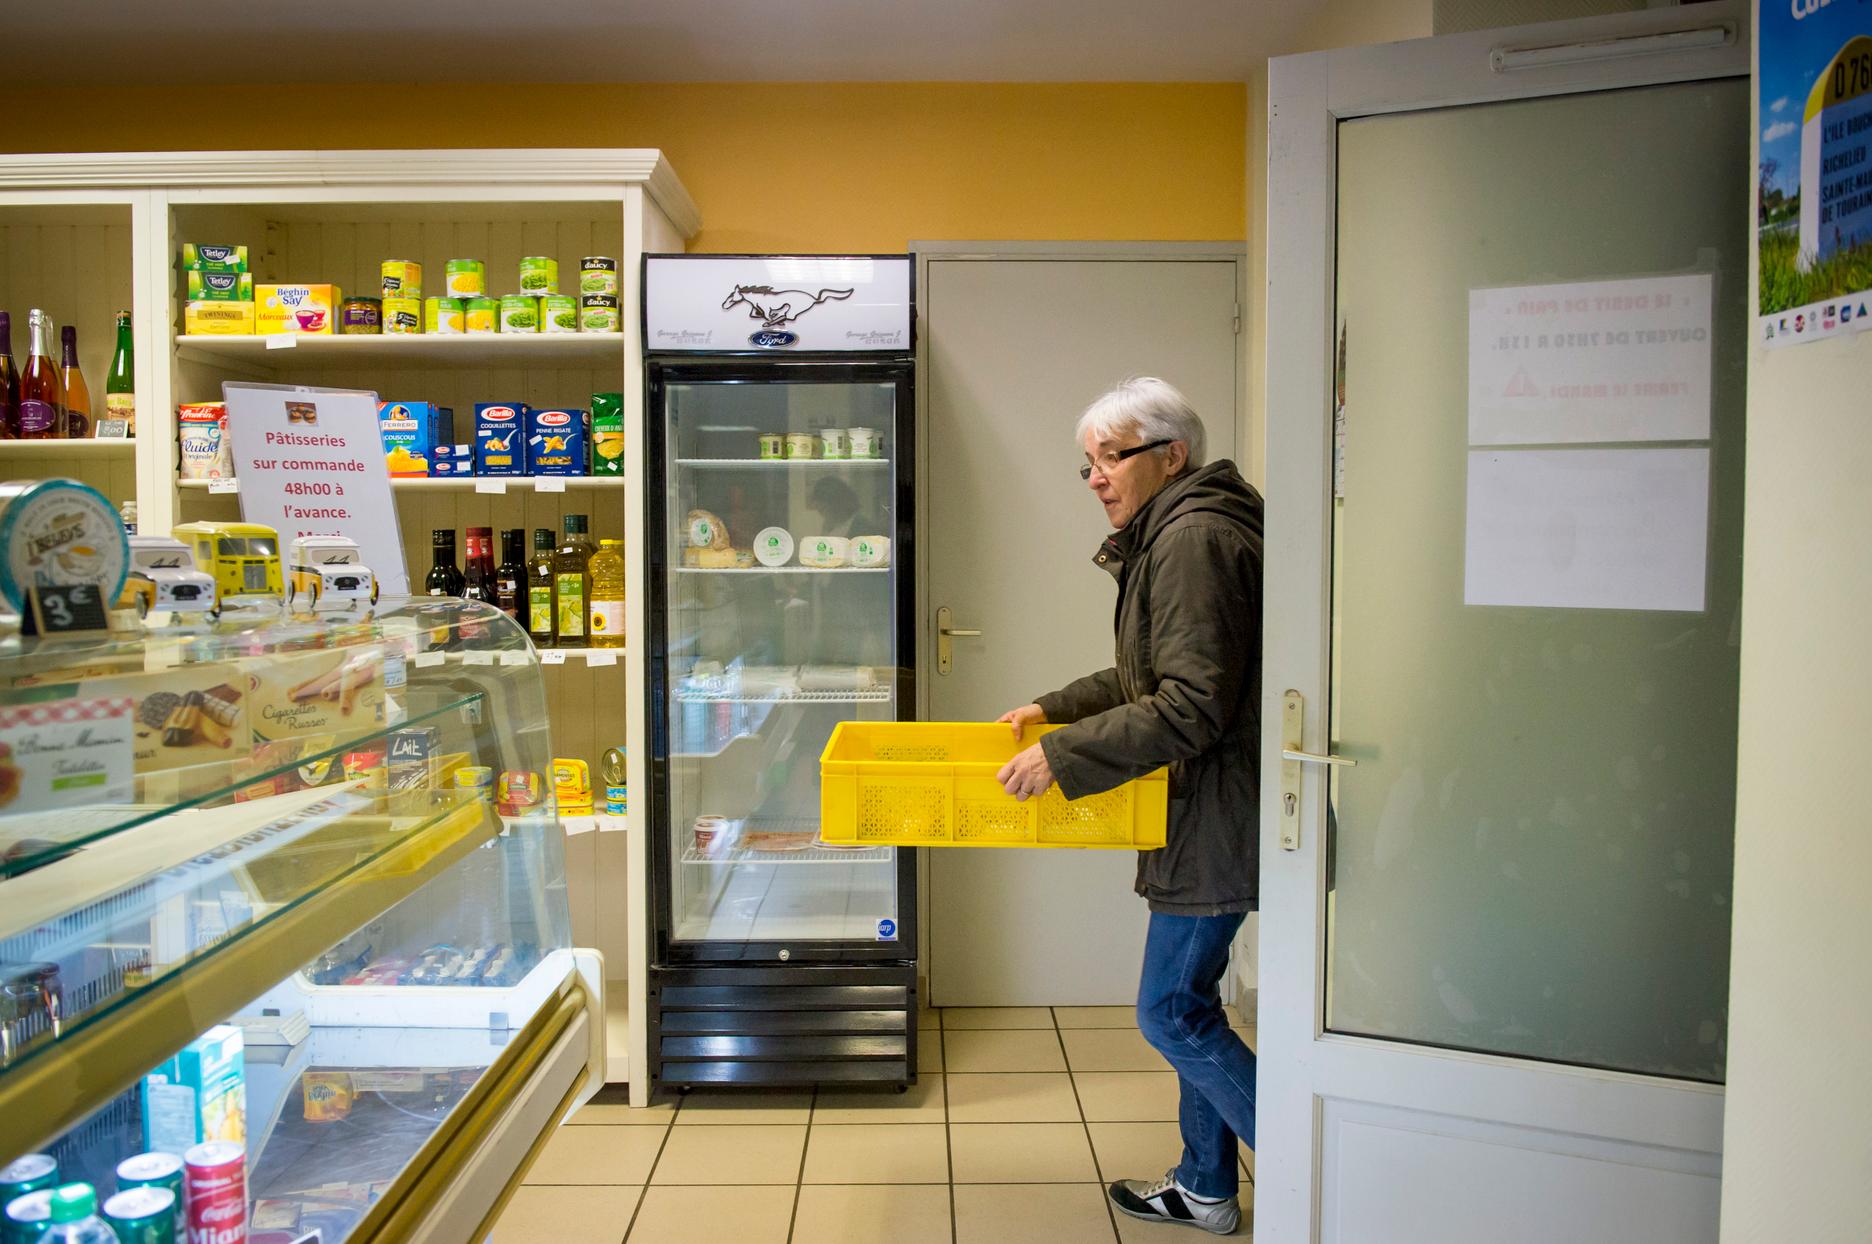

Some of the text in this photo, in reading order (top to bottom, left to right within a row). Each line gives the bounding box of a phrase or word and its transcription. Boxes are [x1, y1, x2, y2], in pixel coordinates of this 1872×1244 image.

[1850, 53, 1872, 95] 76
[1823, 145, 1866, 176] RICHELIEU
[1822, 204, 1833, 224] DE
[204, 248, 226, 259] Tetley
[209, 276, 231, 287] Tetley
[282, 296, 303, 306] Say
[758, 333, 787, 346] Ford
[488, 409, 513, 419] Barilla
[544, 414, 568, 424] Barilla
[265, 432, 346, 448] Pâtisseries
[253, 458, 365, 472] sur commande
[284, 482, 344, 496] 48h00 à
[284, 505, 352, 519] l'avance.
[262, 703, 317, 724] Cigarettes
[286, 716, 328, 730] Russes
